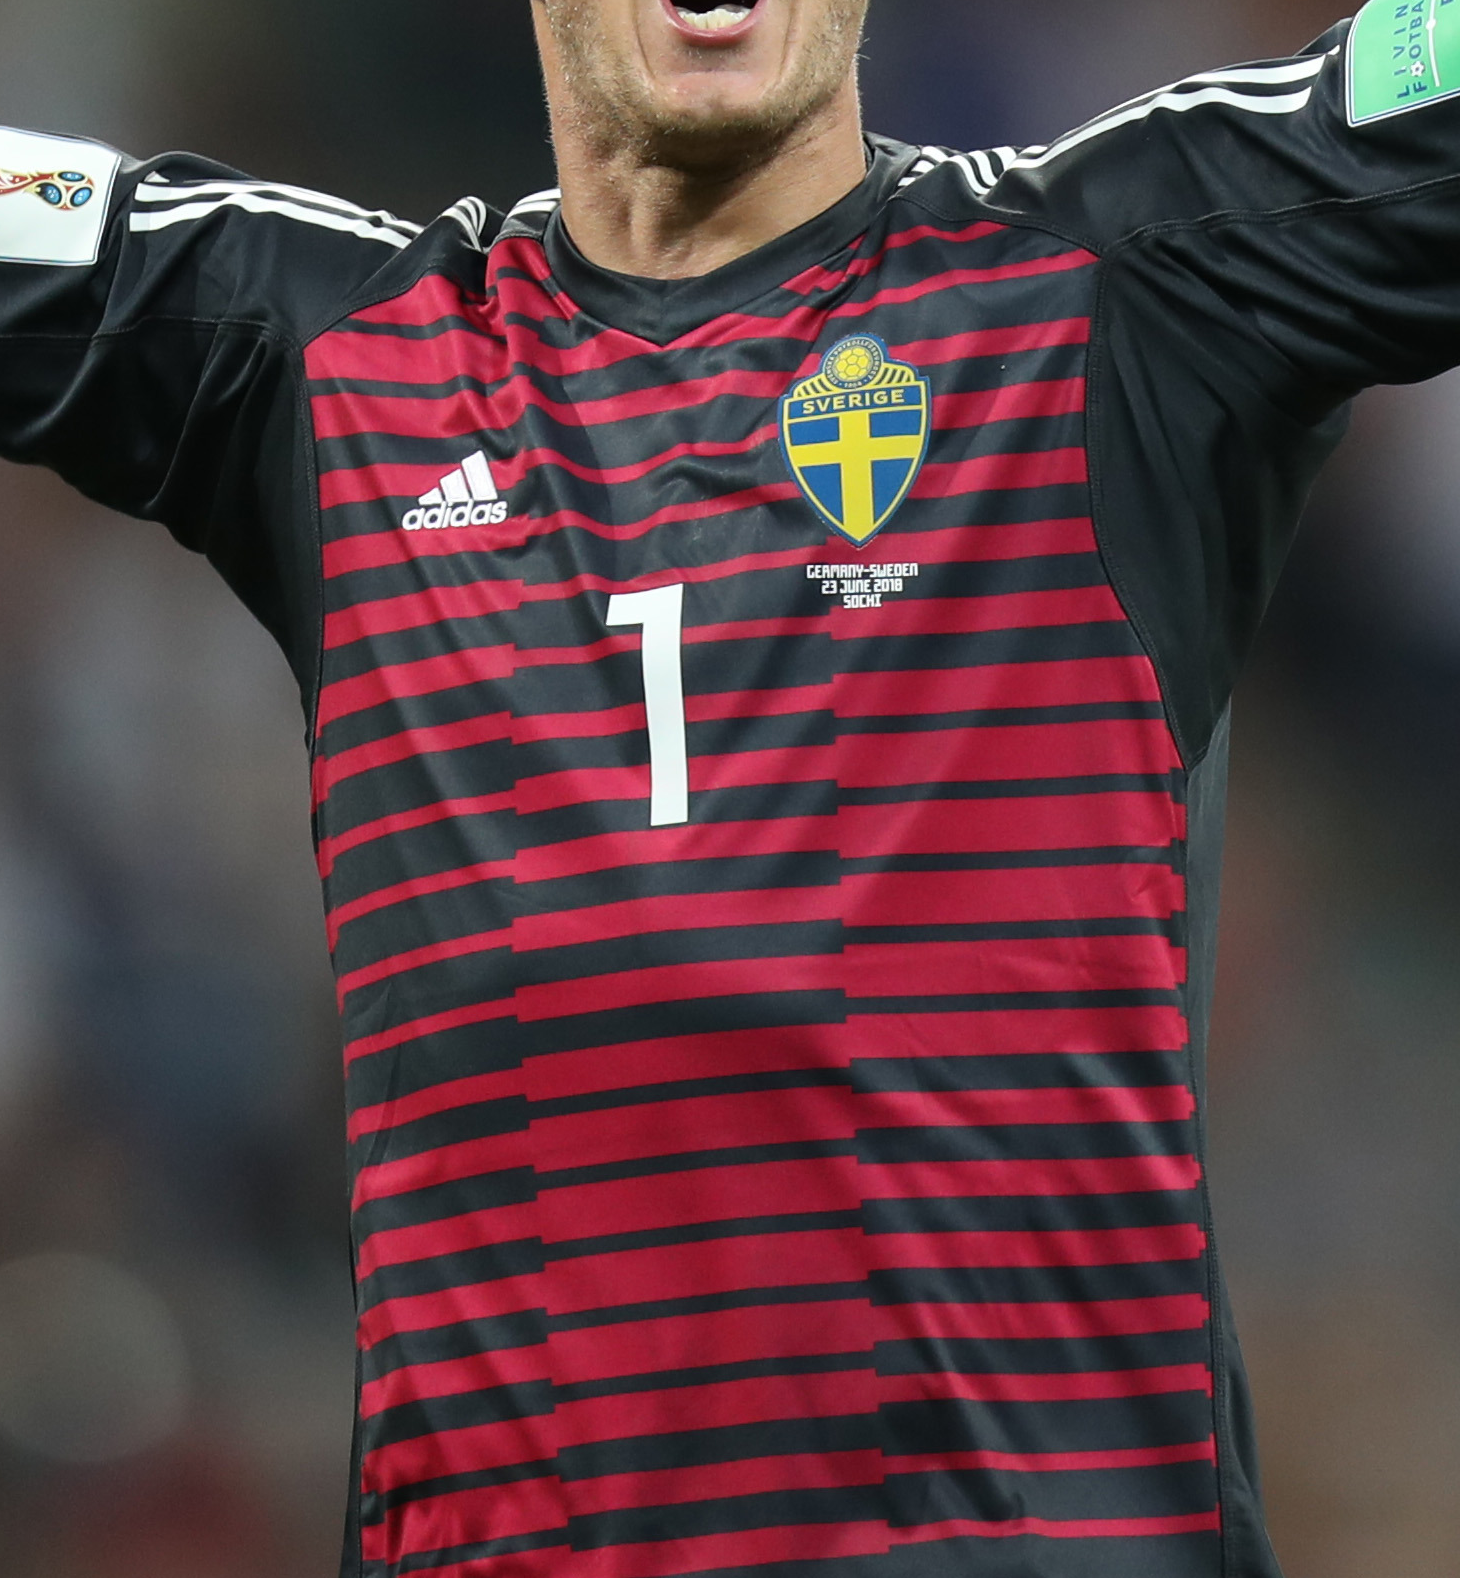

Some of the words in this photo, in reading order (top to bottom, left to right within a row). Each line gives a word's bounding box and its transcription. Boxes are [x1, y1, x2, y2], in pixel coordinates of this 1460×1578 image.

[802, 389, 905, 414] SVERIGE
[402, 498, 508, 531] adidas
[821, 580, 838, 594] 23
[839, 579, 872, 594] JUNE
[873, 578, 903, 593] 2018
[843, 593, 882, 609] SOCHI
[606, 582, 688, 826] 1
